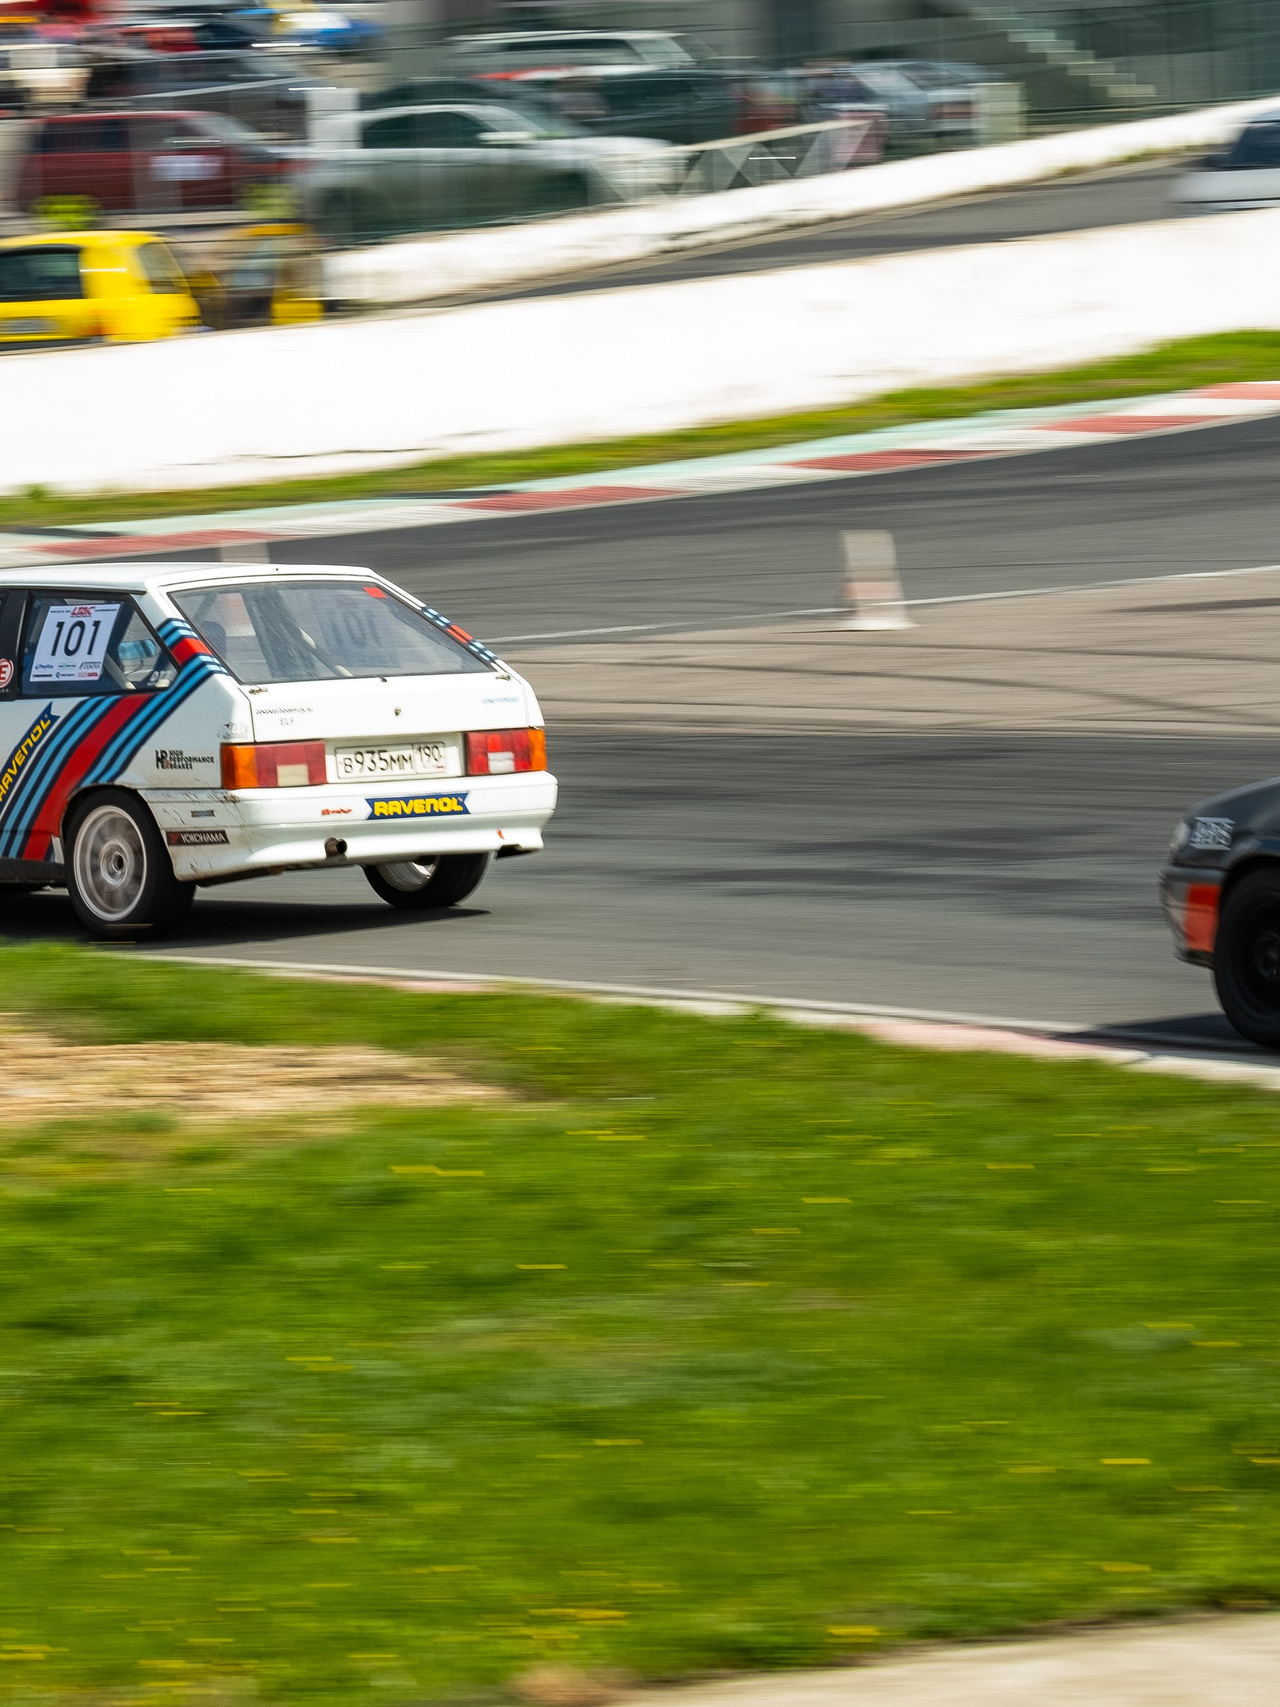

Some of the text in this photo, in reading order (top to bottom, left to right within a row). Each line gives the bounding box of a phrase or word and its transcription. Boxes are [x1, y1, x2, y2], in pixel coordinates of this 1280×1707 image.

[51, 620, 102, 657] 101
[374, 797, 463, 817] RAVENOL
[180, 832, 227, 844] YOKOHAMA
